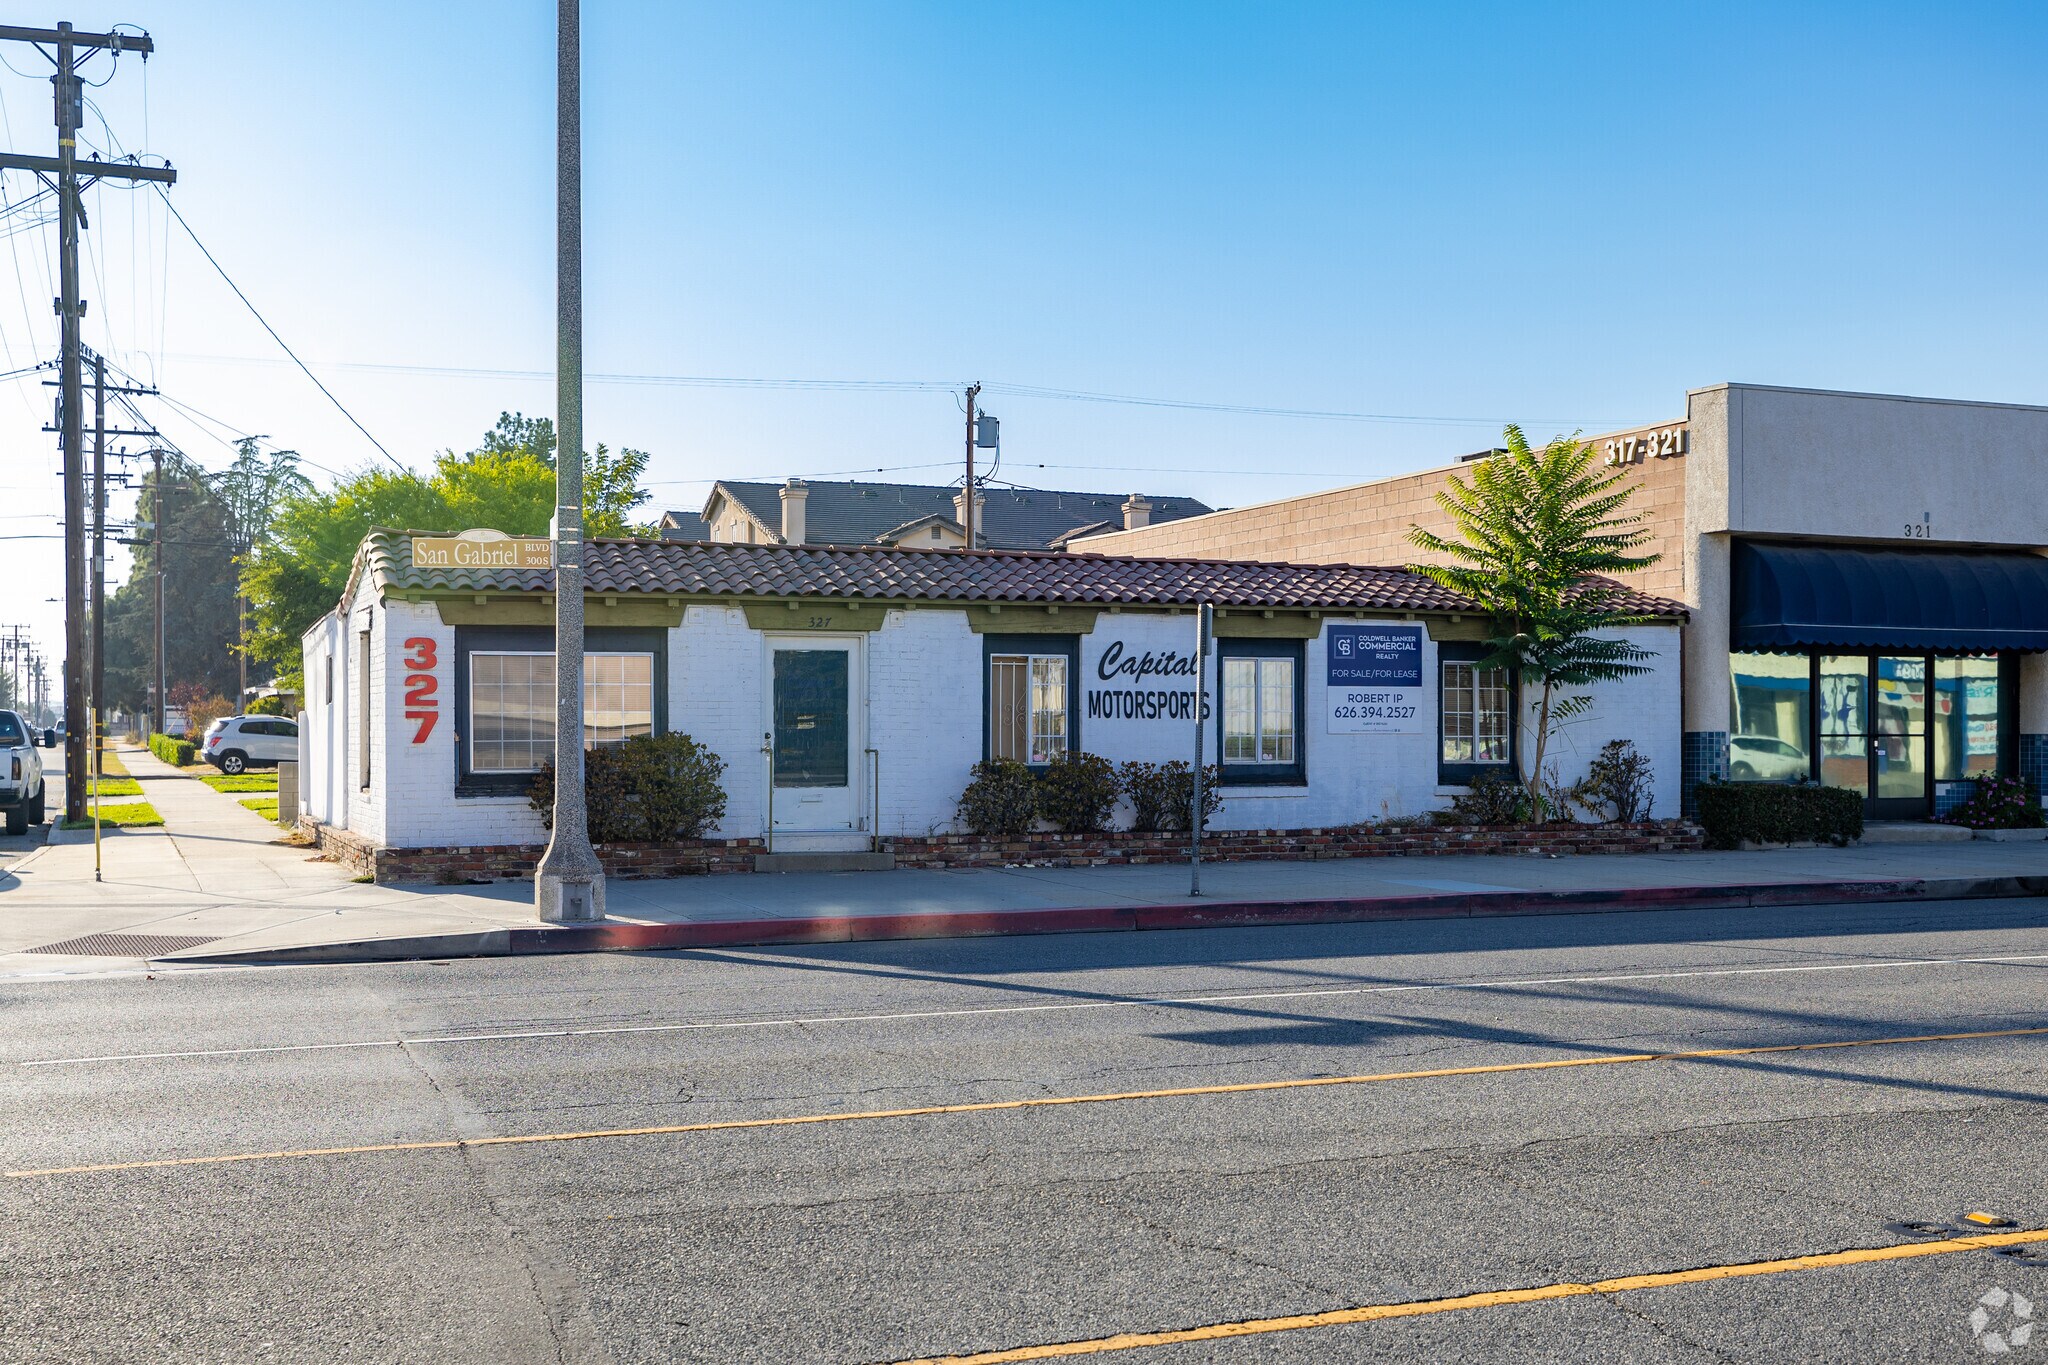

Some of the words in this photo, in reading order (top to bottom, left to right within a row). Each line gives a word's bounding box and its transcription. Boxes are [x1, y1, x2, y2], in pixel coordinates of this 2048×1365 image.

[1604, 427, 1682, 465] 317-321
[1904, 524, 1930, 538] 321
[525, 543, 549, 552] BLVD
[416, 542, 449, 565] San
[454, 542, 519, 566] Gabriel
[525, 556, 549, 565] 300S
[808, 616, 832, 628] 327
[1358, 642, 1416, 650] COMMERCIAL
[1097, 640, 1199, 684] Capital
[1332, 669, 1349, 678] FOR
[1393, 669, 1418, 678] LEASE
[1347, 693, 1390, 703] ROBERT
[1393, 693, 1404, 703] IP
[1334, 706, 1416, 718] 626.394.2527
